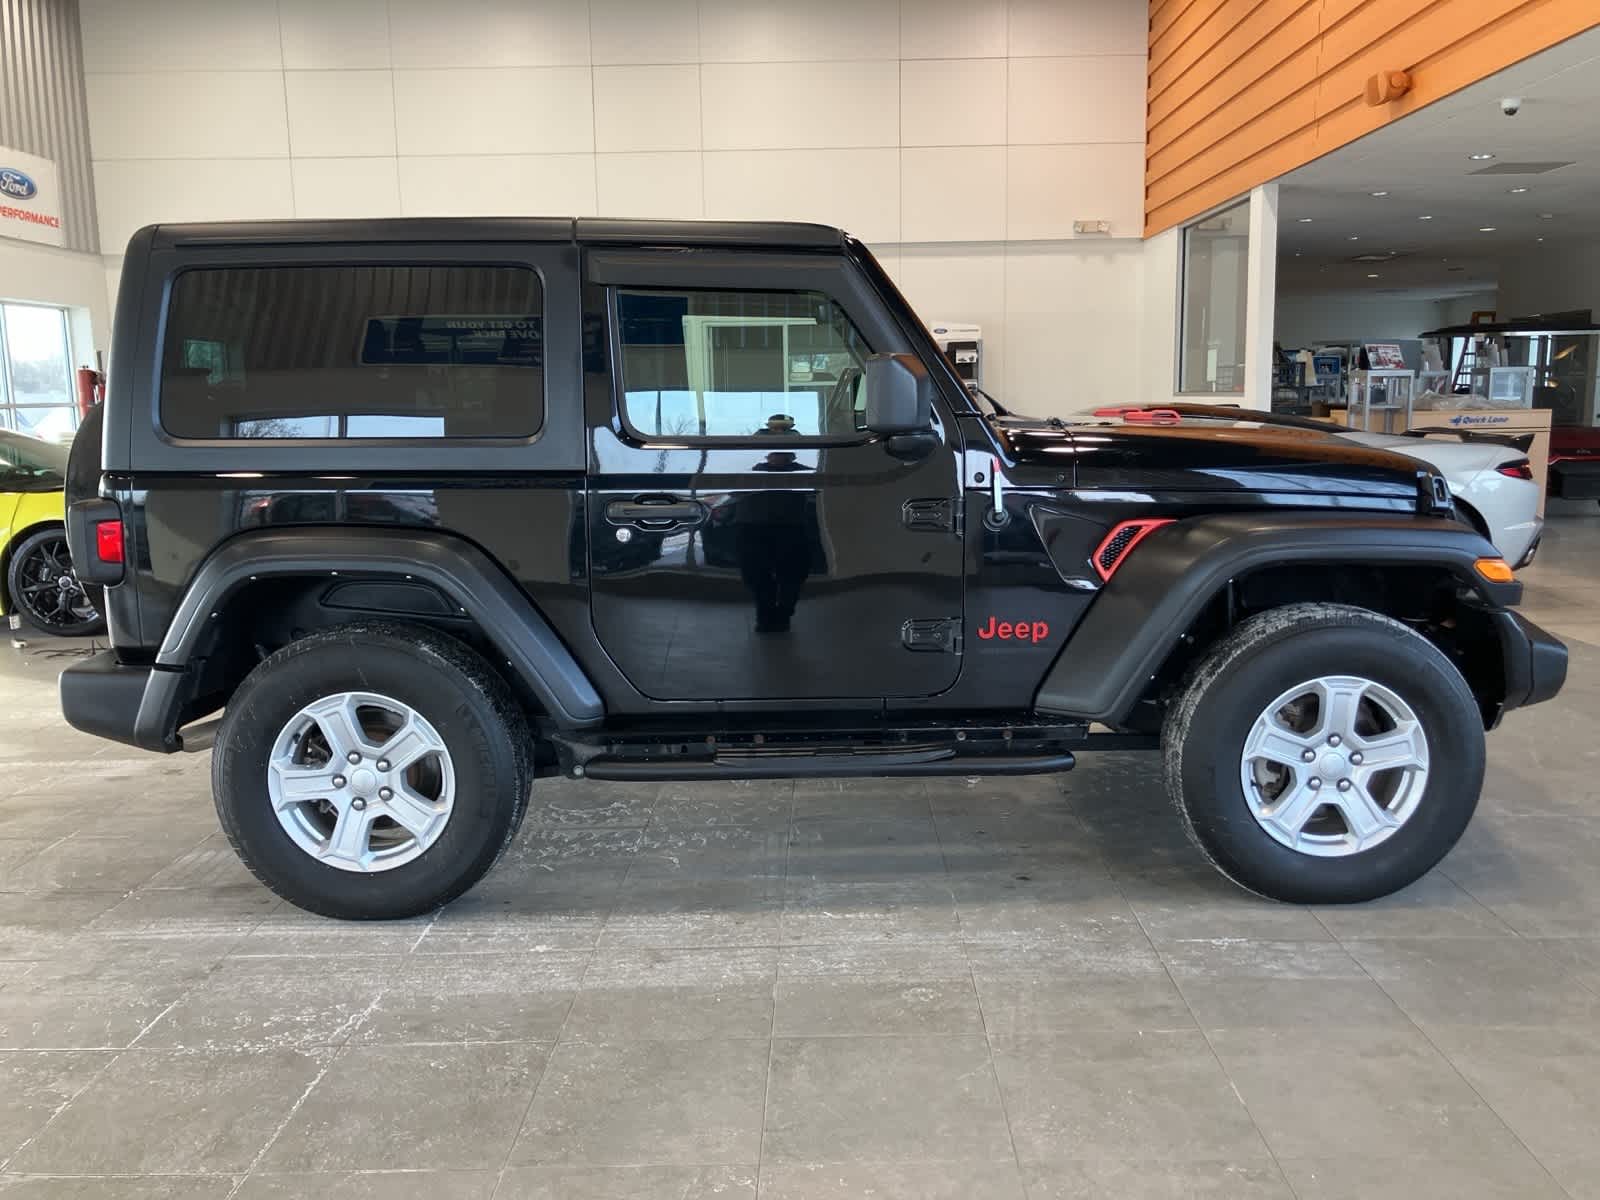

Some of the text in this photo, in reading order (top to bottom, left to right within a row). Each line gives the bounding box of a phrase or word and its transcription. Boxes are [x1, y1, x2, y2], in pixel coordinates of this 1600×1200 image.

[0, 172, 28, 195] Ford
[1462, 415, 1509, 424] Quick Lane
[978, 616, 1049, 643] Jeep
